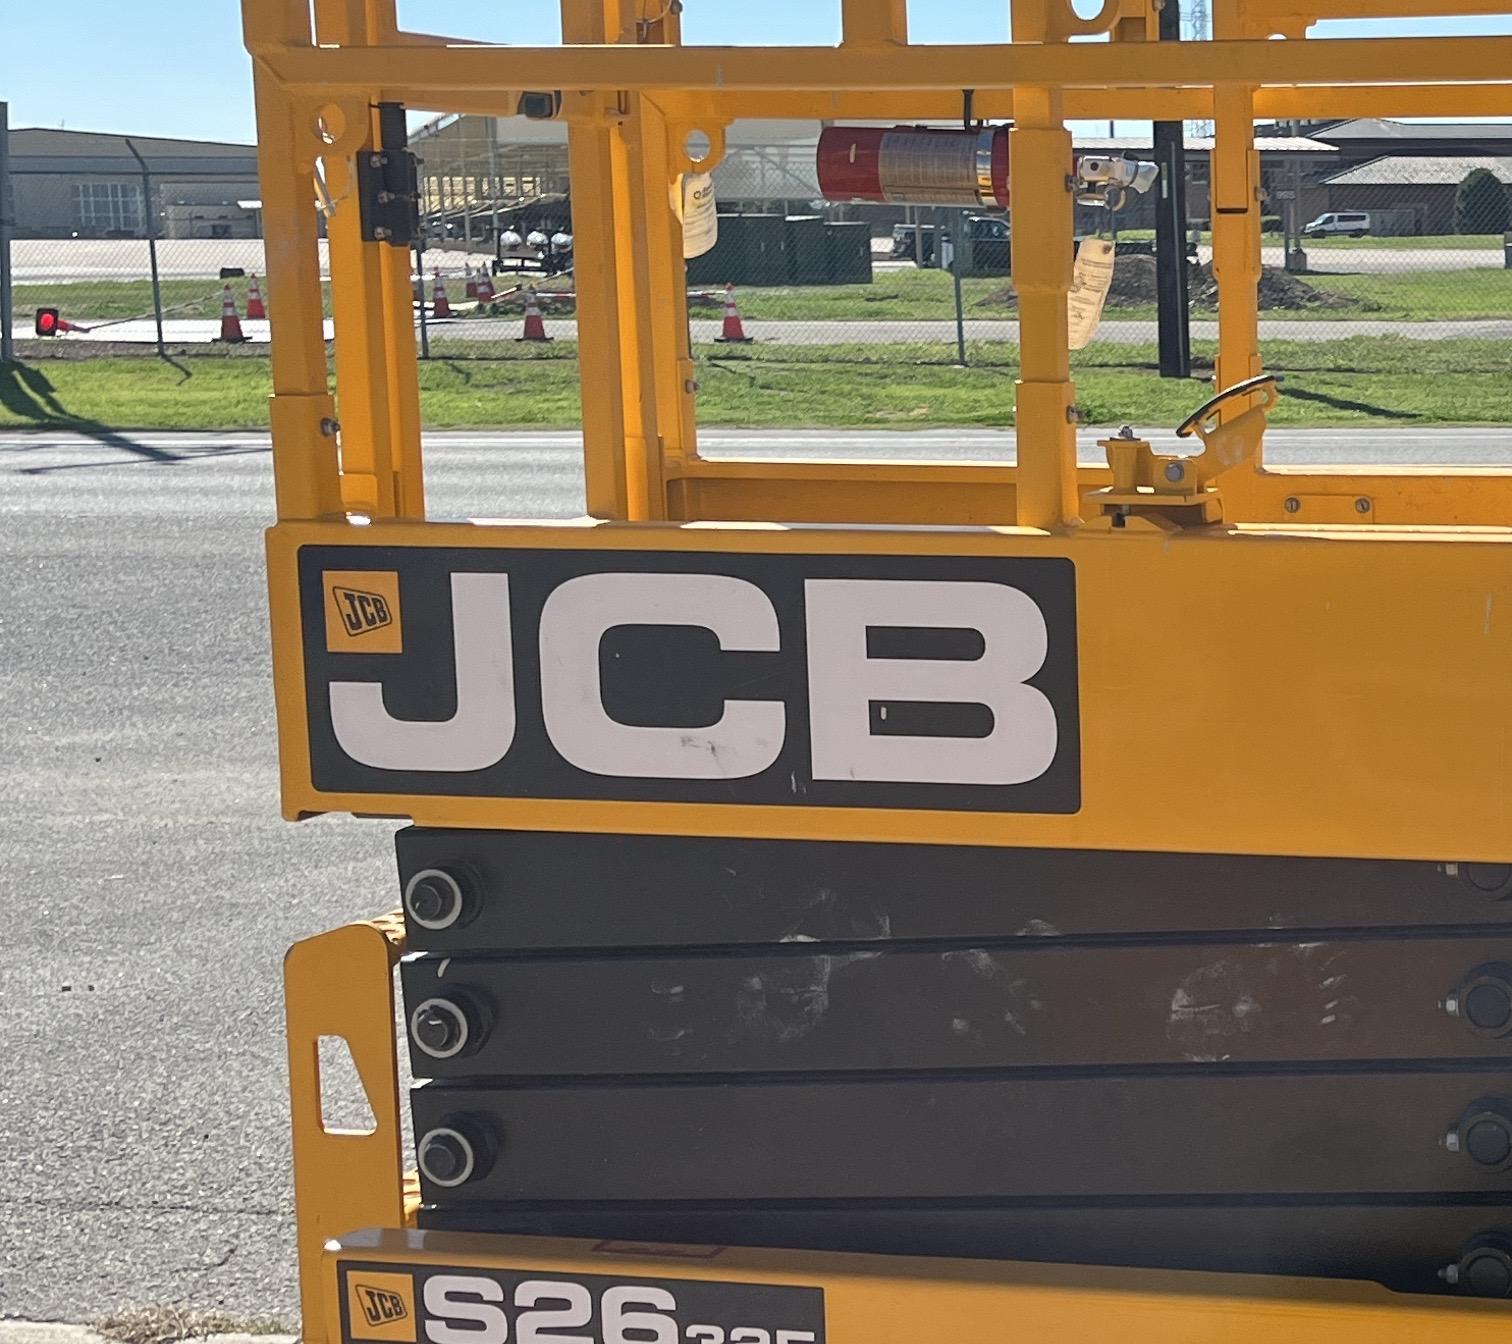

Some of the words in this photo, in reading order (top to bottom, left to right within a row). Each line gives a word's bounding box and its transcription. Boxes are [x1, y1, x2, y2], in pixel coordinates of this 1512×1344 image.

[342, 591, 390, 631] JCB
[328, 571, 1058, 786] JCB
[364, 1288, 403, 1322] JCB
